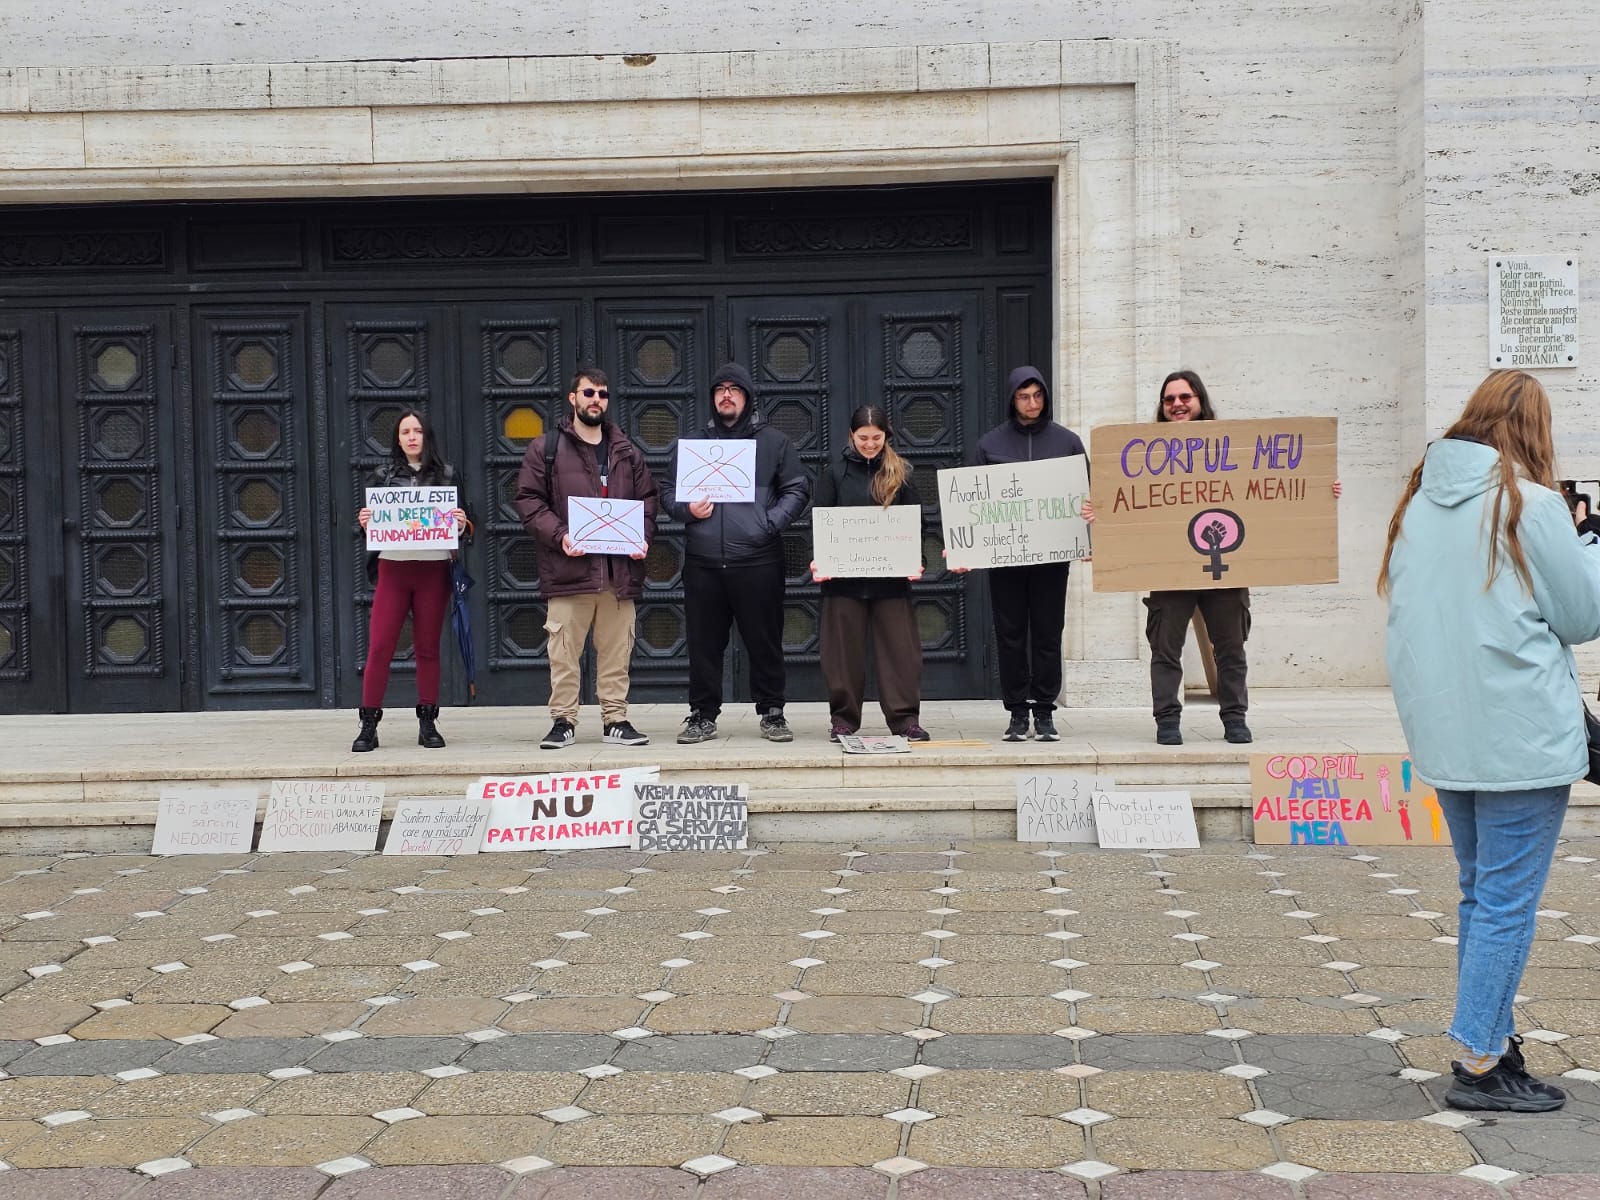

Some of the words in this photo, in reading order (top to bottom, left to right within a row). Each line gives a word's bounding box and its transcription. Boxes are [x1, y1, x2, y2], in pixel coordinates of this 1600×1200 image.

[1500, 270, 1521, 280] Celor
[1523, 280, 1538, 288] sau
[1500, 307, 1521, 316] Peste
[1523, 306, 1547, 315] urmele
[1549, 305, 1577, 315] noastre
[1500, 316, 1512, 325] Ale
[1513, 316, 1532, 325] celor
[1533, 316, 1549, 325] care
[1550, 316, 1561, 324] am
[1562, 315, 1577, 325] fost
[1543, 325, 1553, 334] lui
[1518, 335, 1560, 344] Decembrie
[1500, 343, 1512, 353] Un
[1515, 343, 1541, 354] singur
[1120, 435, 1238, 478] CORPUL
[1252, 433, 1303, 470] MEU
[949, 474, 991, 504] Avortul
[1001, 472, 1024, 499] este
[1113, 479, 1234, 513] ALEGEREA
[1245, 477, 1306, 501] MEA!!!
[369, 490, 424, 504] AVORTUL
[428, 490, 455, 503] ESTE
[372, 510, 392, 523] UN
[398, 506, 433, 521] DREPT
[842, 514, 880, 528] primul
[369, 528, 454, 542] FUNDAMENTAL
[830, 530, 839, 544] la
[949, 525, 974, 550] NU
[983, 523, 1016, 547] subiect
[1017, 523, 1030, 544] de
[990, 544, 1044, 565] dezbatere
[1266, 755, 1365, 780] CORPUL
[275, 782, 337, 795] VICTIME
[341, 781, 372, 793] ALE
[482, 774, 621, 799] EGALITATE
[634, 785, 674, 801] VREM
[677, 784, 746, 801] AVORTUL
[1024, 776, 1037, 798] 1
[1044, 776, 1059, 797] 2
[1071, 779, 1079, 799] 3
[1287, 778, 1341, 799] MEU
[531, 794, 594, 820] NU
[639, 801, 747, 821] GARANTAT
[1098, 793, 1153, 813] Avortul
[1169, 803, 1183, 811] un
[1253, 796, 1374, 821] ALEGEREA
[400, 808, 431, 824] Suntem
[1120, 812, 1174, 826] DREPT
[402, 828, 420, 838] care
[636, 819, 660, 835] CA
[665, 819, 747, 837] SERVICIU
[1102, 828, 1128, 844] NU
[1151, 828, 1186, 844] LUX
[1289, 821, 1349, 846] MEA
[170, 832, 241, 845] NEDORITE
[435, 838, 463, 855] 770
[639, 835, 743, 851] DECONTAT
